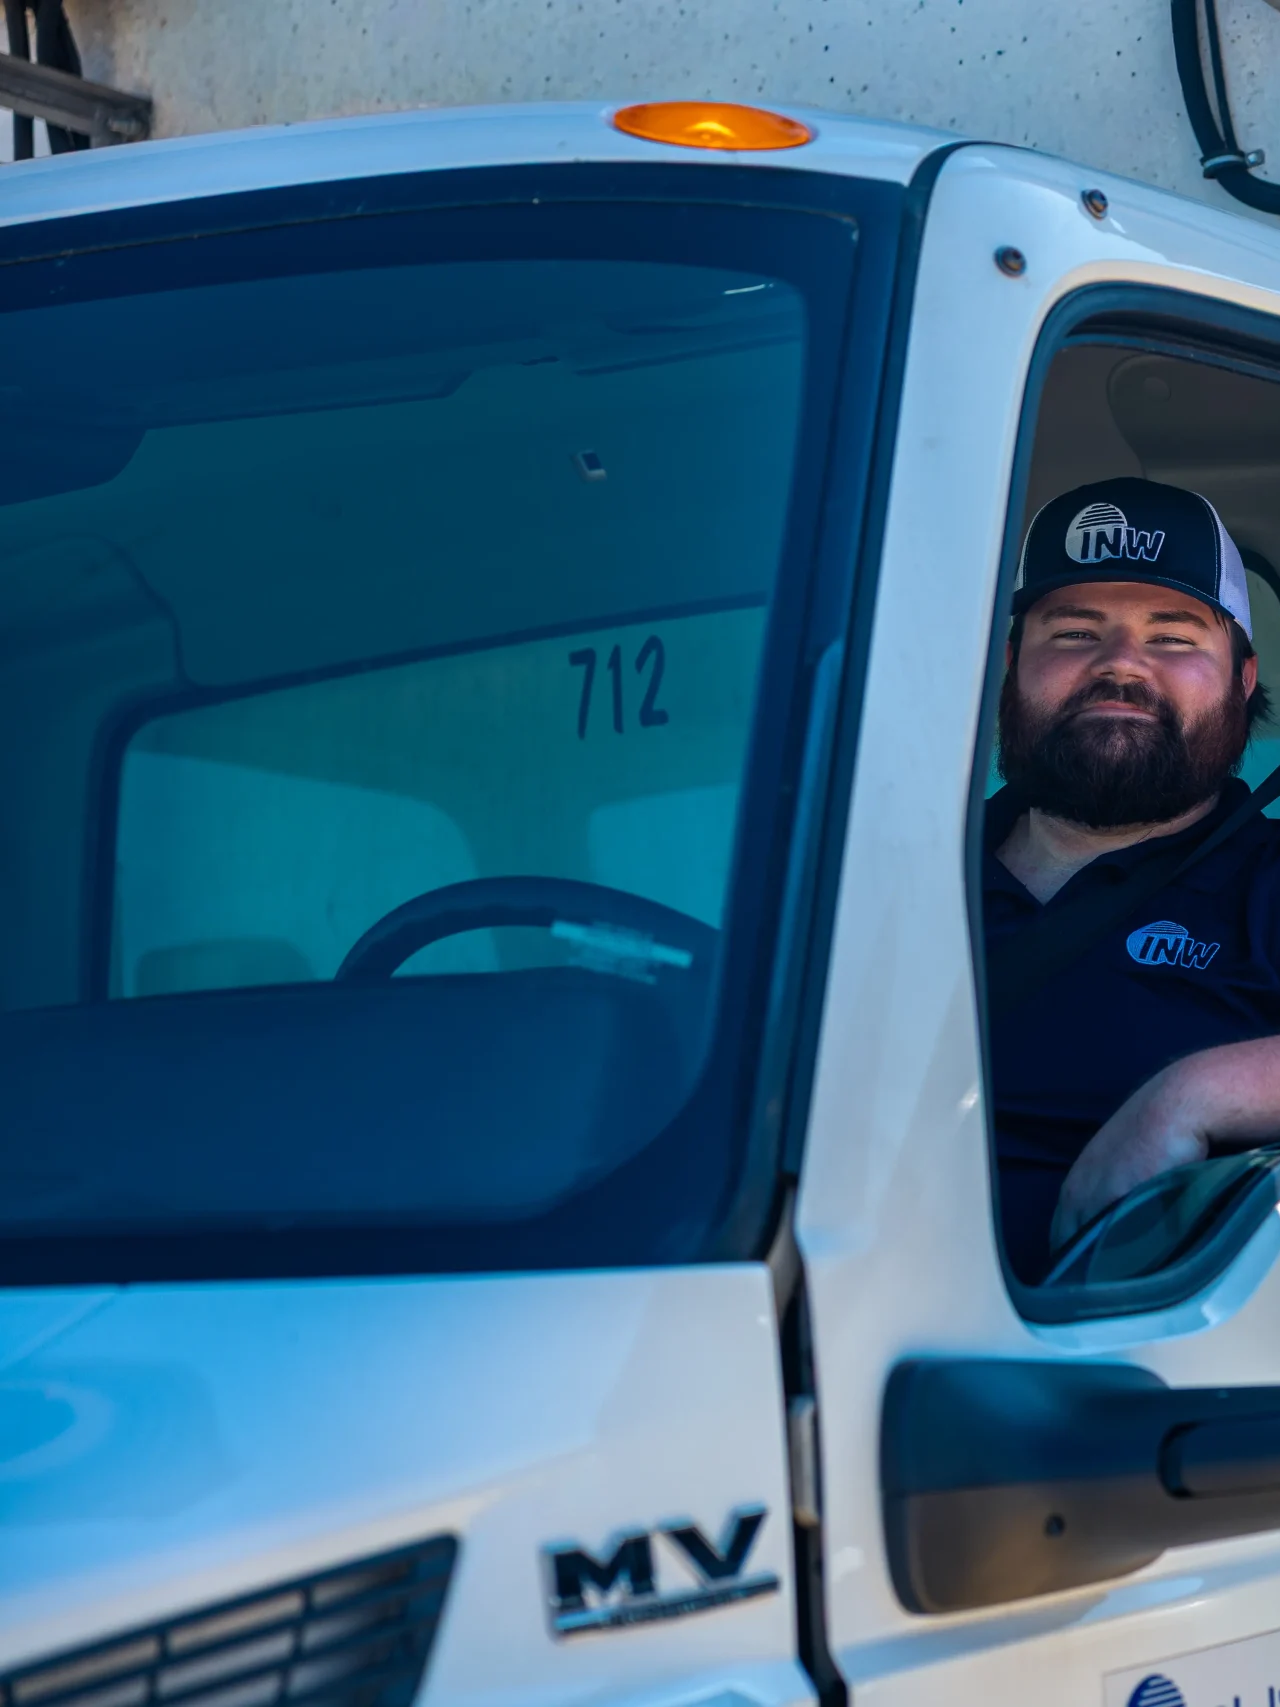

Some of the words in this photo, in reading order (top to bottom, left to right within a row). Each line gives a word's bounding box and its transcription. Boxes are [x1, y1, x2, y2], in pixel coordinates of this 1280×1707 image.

[1079, 526, 1165, 562] INW
[568, 634, 669, 740] 712
[1138, 936, 1221, 970] INW
[541, 1501, 768, 1611] MV
